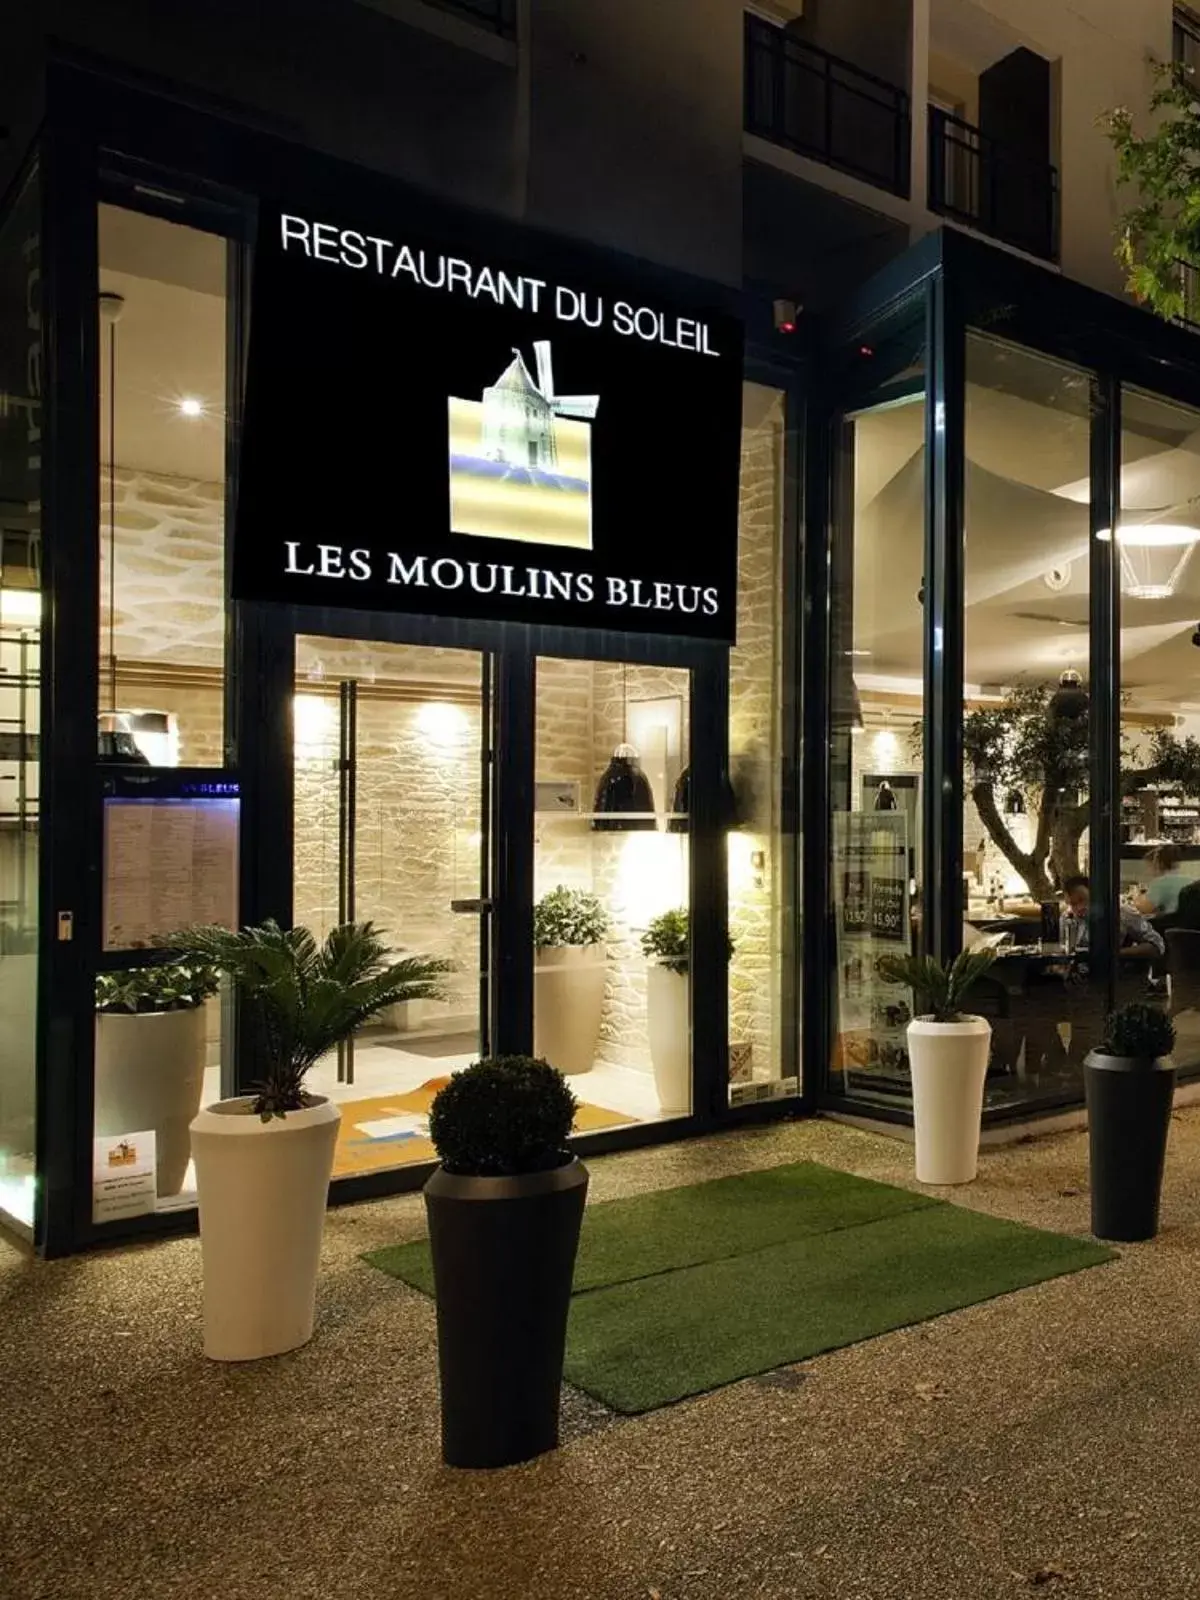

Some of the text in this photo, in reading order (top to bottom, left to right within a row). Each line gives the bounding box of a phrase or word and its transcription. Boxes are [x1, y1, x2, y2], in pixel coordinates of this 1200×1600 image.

[281, 213, 720, 357] RESTAURANT DU SOLEIL
[284, 541, 719, 615] LES MOULINS BLEUS
